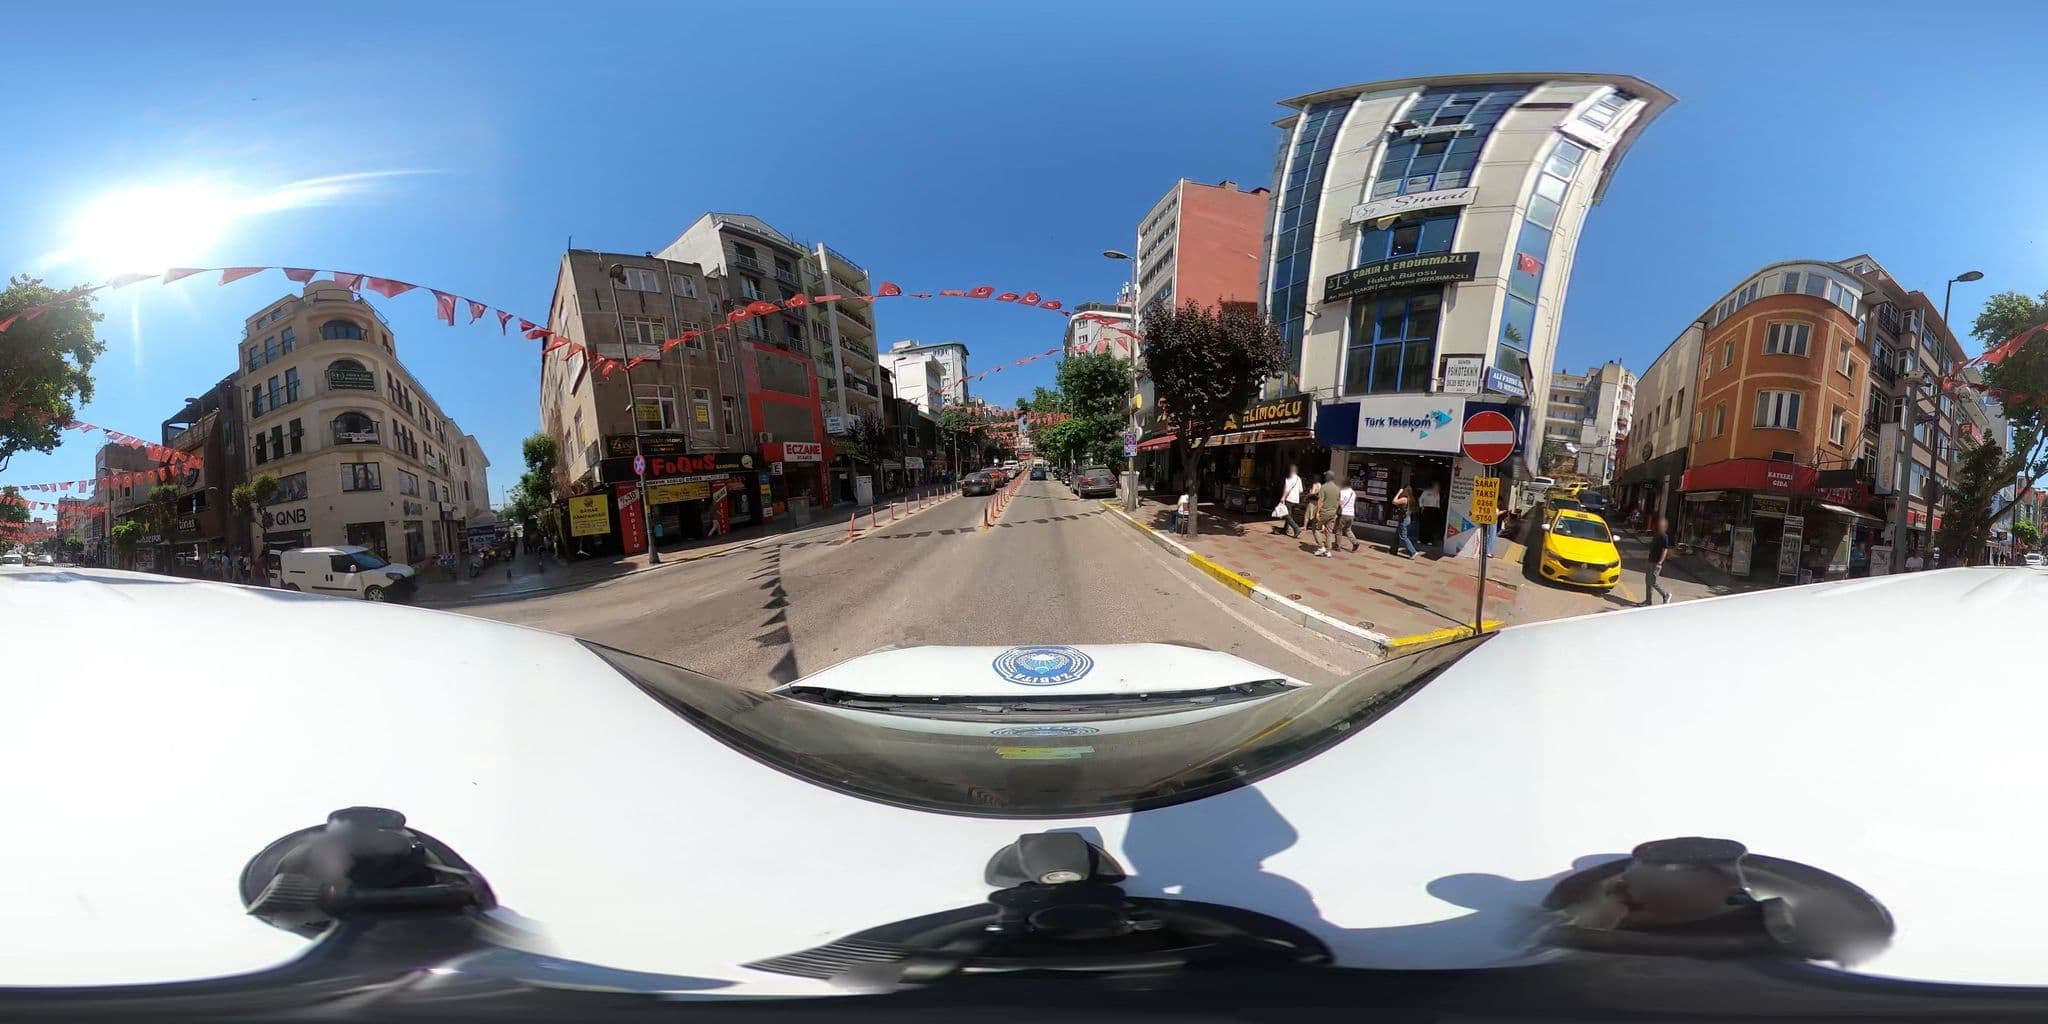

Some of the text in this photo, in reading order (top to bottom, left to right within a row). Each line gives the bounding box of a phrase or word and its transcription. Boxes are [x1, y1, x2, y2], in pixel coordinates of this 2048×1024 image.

[1352, 254, 1468, 279] ÇAKIR & ERDURMAZLI
[1367, 269, 1437, 285] Hukuk Bürosu
[1364, 415, 1431, 427] Türk Telekom
[786, 444, 821, 455] ECZANE
[1475, 479, 1498, 488] SARAY
[1476, 489, 1496, 498] TAKSİ
[1476, 499, 1494, 507] 0266
[276, 508, 307, 526] QNB
